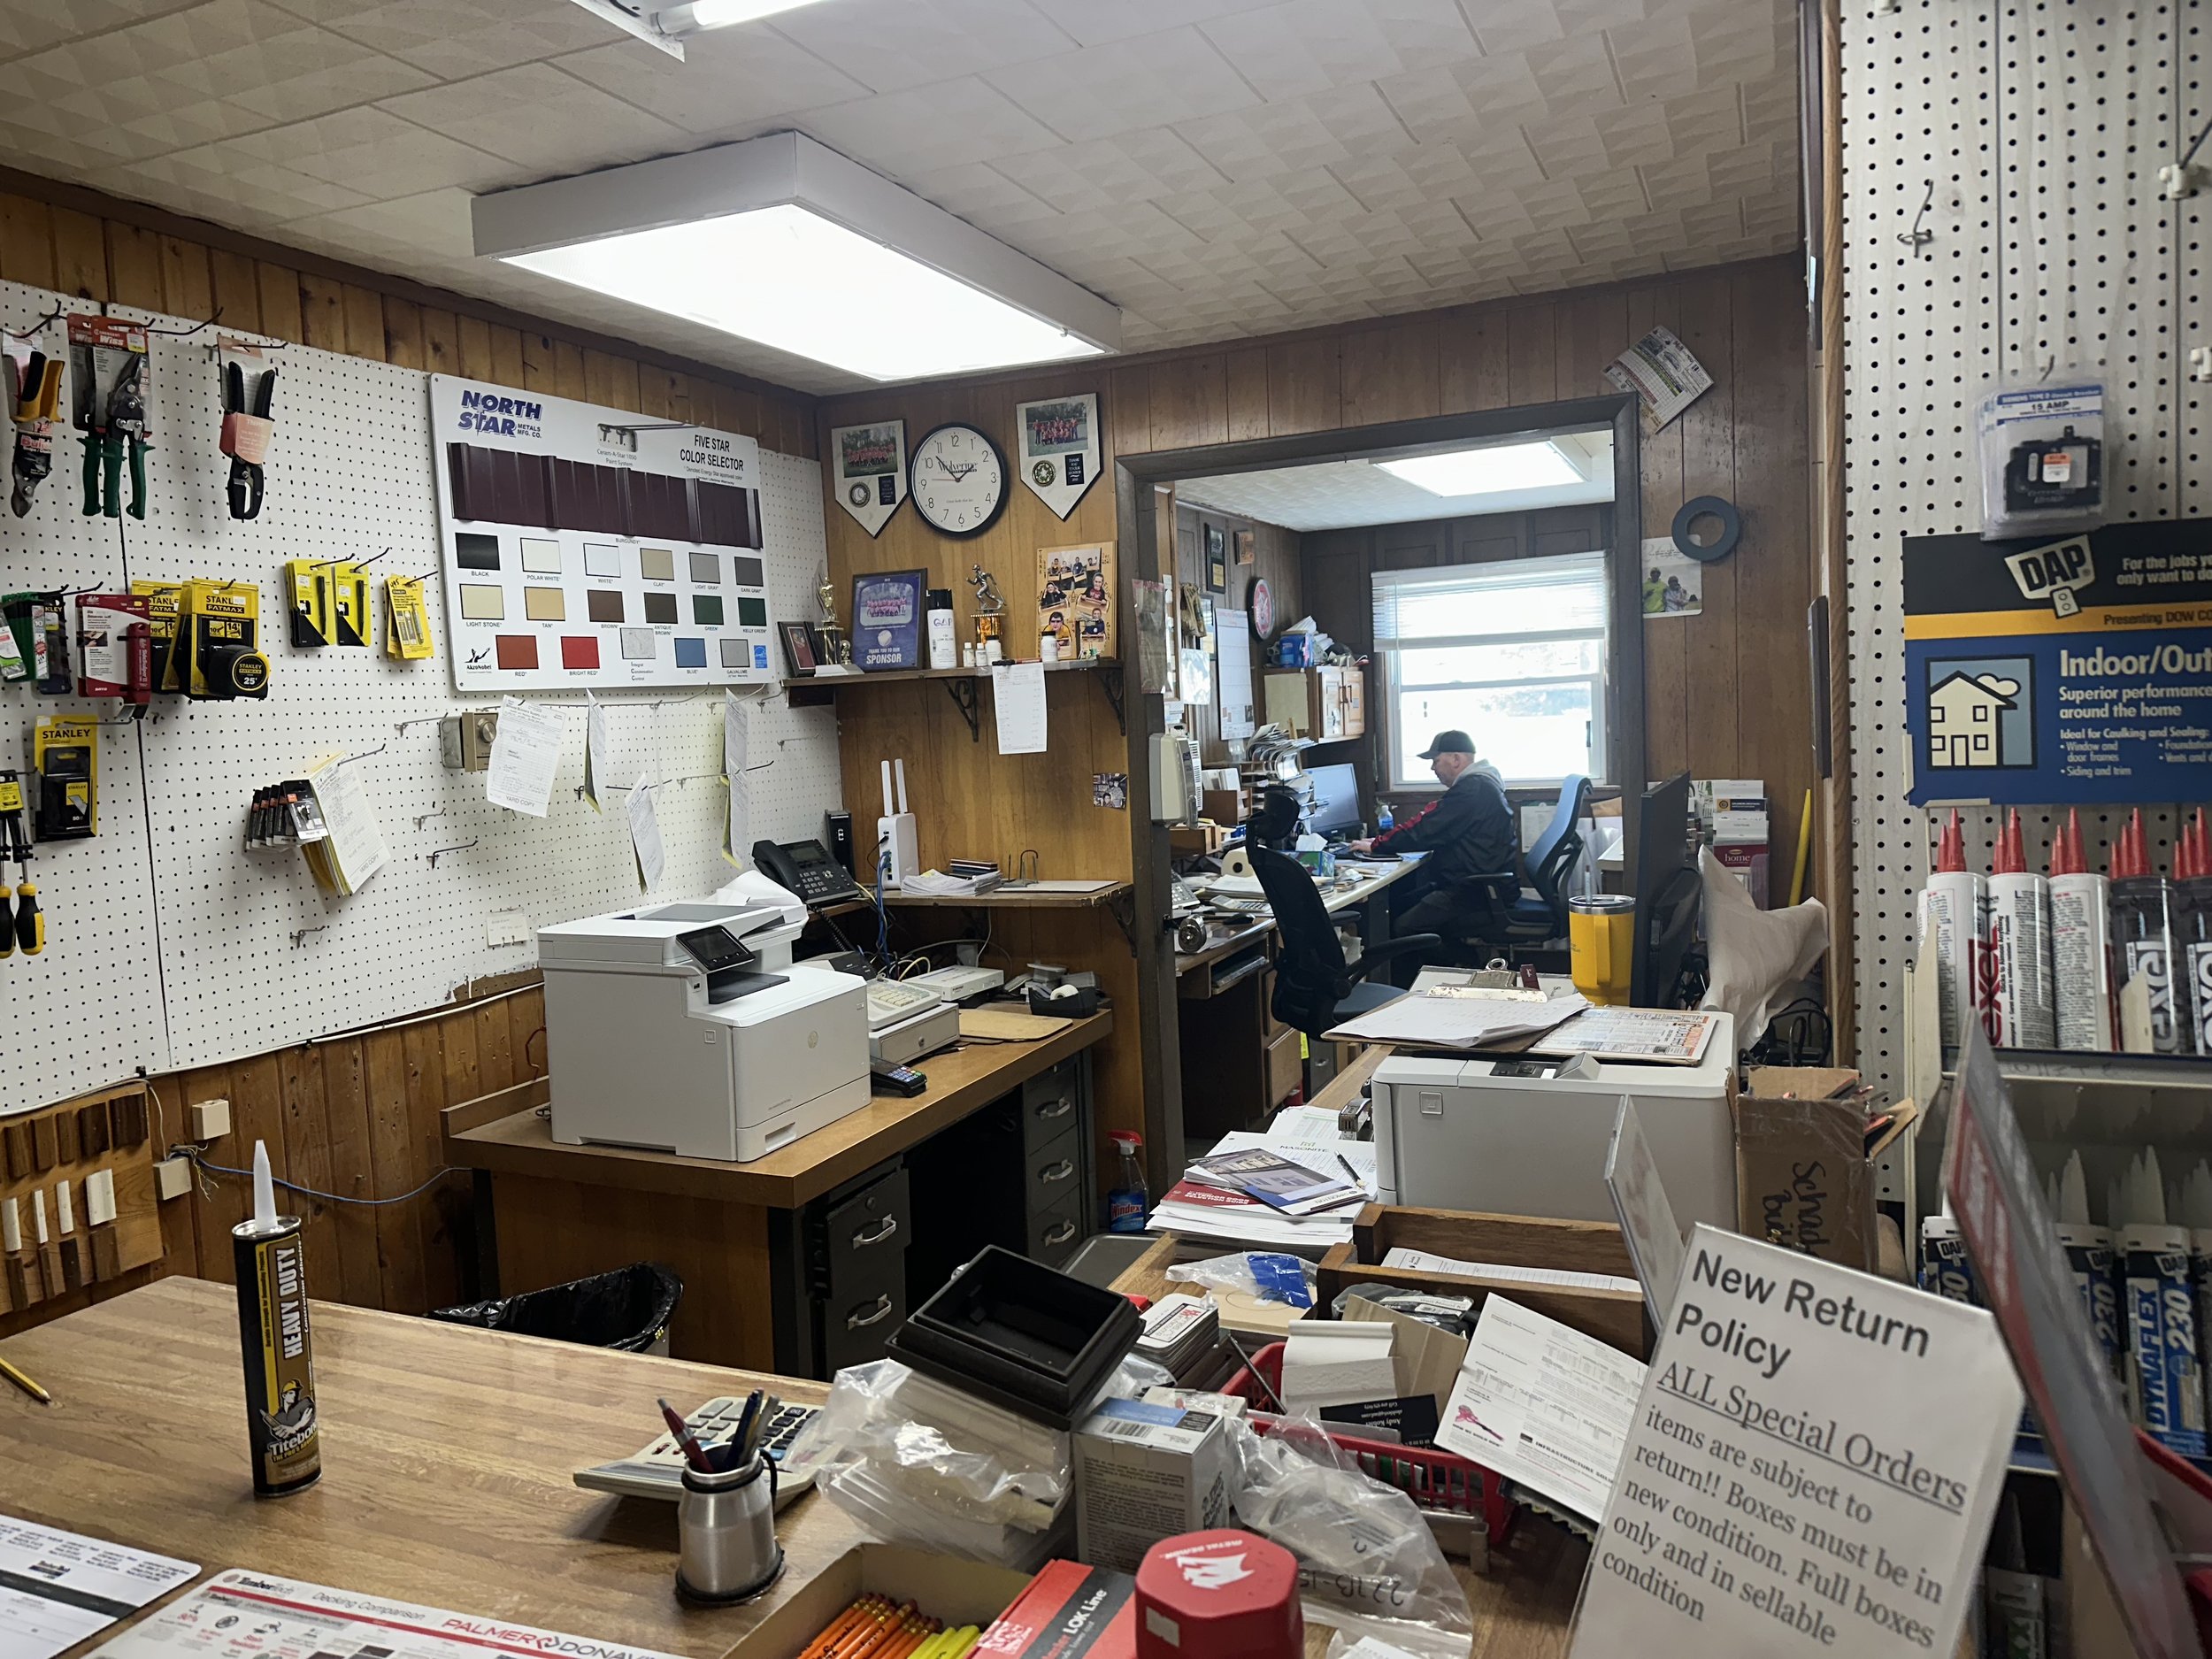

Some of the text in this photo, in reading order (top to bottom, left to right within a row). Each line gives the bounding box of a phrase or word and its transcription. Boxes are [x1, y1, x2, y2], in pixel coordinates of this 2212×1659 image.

[461, 390, 541, 420] NORTH
[2032, 403, 2044, 411] 15
[2047, 400, 2070, 410] AMP
[457, 411, 516, 436] STAR
[518, 423, 541, 432] METALS
[694, 434, 730, 452] FIVE STAR
[937, 442, 942, 454] 11
[951, 434, 959, 447] 12
[680, 449, 744, 472] COLOR SELECTOR
[925, 457, 933, 469] 10
[982, 450, 988, 462] 2
[920, 479, 926, 490] 9
[991, 472, 997, 483] 3
[928, 497, 934, 508] 8
[986, 493, 991, 503] 4
[943, 509, 949, 520] 7
[958, 513, 964, 524] 6
[974, 506, 981, 518] 5
[2017, 543, 2086, 592] DAP
[2123, 554, 2197, 571] For the jobs
[2116, 572, 2145, 586] only
[2147, 570, 2179, 583] want
[2181, 570, 2195, 581] to
[206, 595, 234, 605] STANL
[2104, 612, 2163, 626] Presenting
[2166, 611, 2194, 623] DOW
[866, 653, 902, 664] SPONSOR
[2059, 683, 2212, 704] Superior performance
[2060, 702, 2182, 718] around the home
[42, 729, 91, 740] STANLEY
[2060, 728, 2085, 740] Ideal
[2088, 727, 2101, 739] for
[2103, 727, 2147, 741] Caulking
[2148, 726, 2168, 738] and
[2066, 740, 2118, 751] Window and
[2067, 751, 2119, 763] door frames
[2067, 766, 2093, 779] Siding
[2095, 764, 2111, 776] and
[1725, 853, 1751, 862] home
[1111, 1203, 1142, 1218] Windex
[276, 1248, 303, 1360] HEAVY DUTY
[297, 1278, 309, 1333] Construction
[1693, 1249, 1931, 1357] New Return
[2093, 1286, 2120, 1348] 230
[2164, 1289, 2194, 1357] 230
[1676, 1303, 1791, 1379] Policy
[2136, 1288, 2166, 1426] DYNAFLEX
[1656, 1361, 1718, 1407] ALL
[1724, 1386, 1837, 1454] Special
[1844, 1433, 1968, 1508] Orders
[1535, 1440, 1594, 1473] INFRASTRUCTURE
[1645, 1405, 1873, 1525] items are subject to
[1634, 1444, 1944, 1604] return!! Boxes must be in
[1624, 1479, 1935, 1649] new condition. Full boxes
[1603, 1551, 1706, 1623] condition
[1614, 1516, 1837, 1647] only and in sellable
[312, 1593, 357, 1608] Decking
[357, 1601, 425, 1621] Comparison
[1063, 1589, 1107, 1636] LOK Line
[442, 1619, 539, 1645] PALMER
